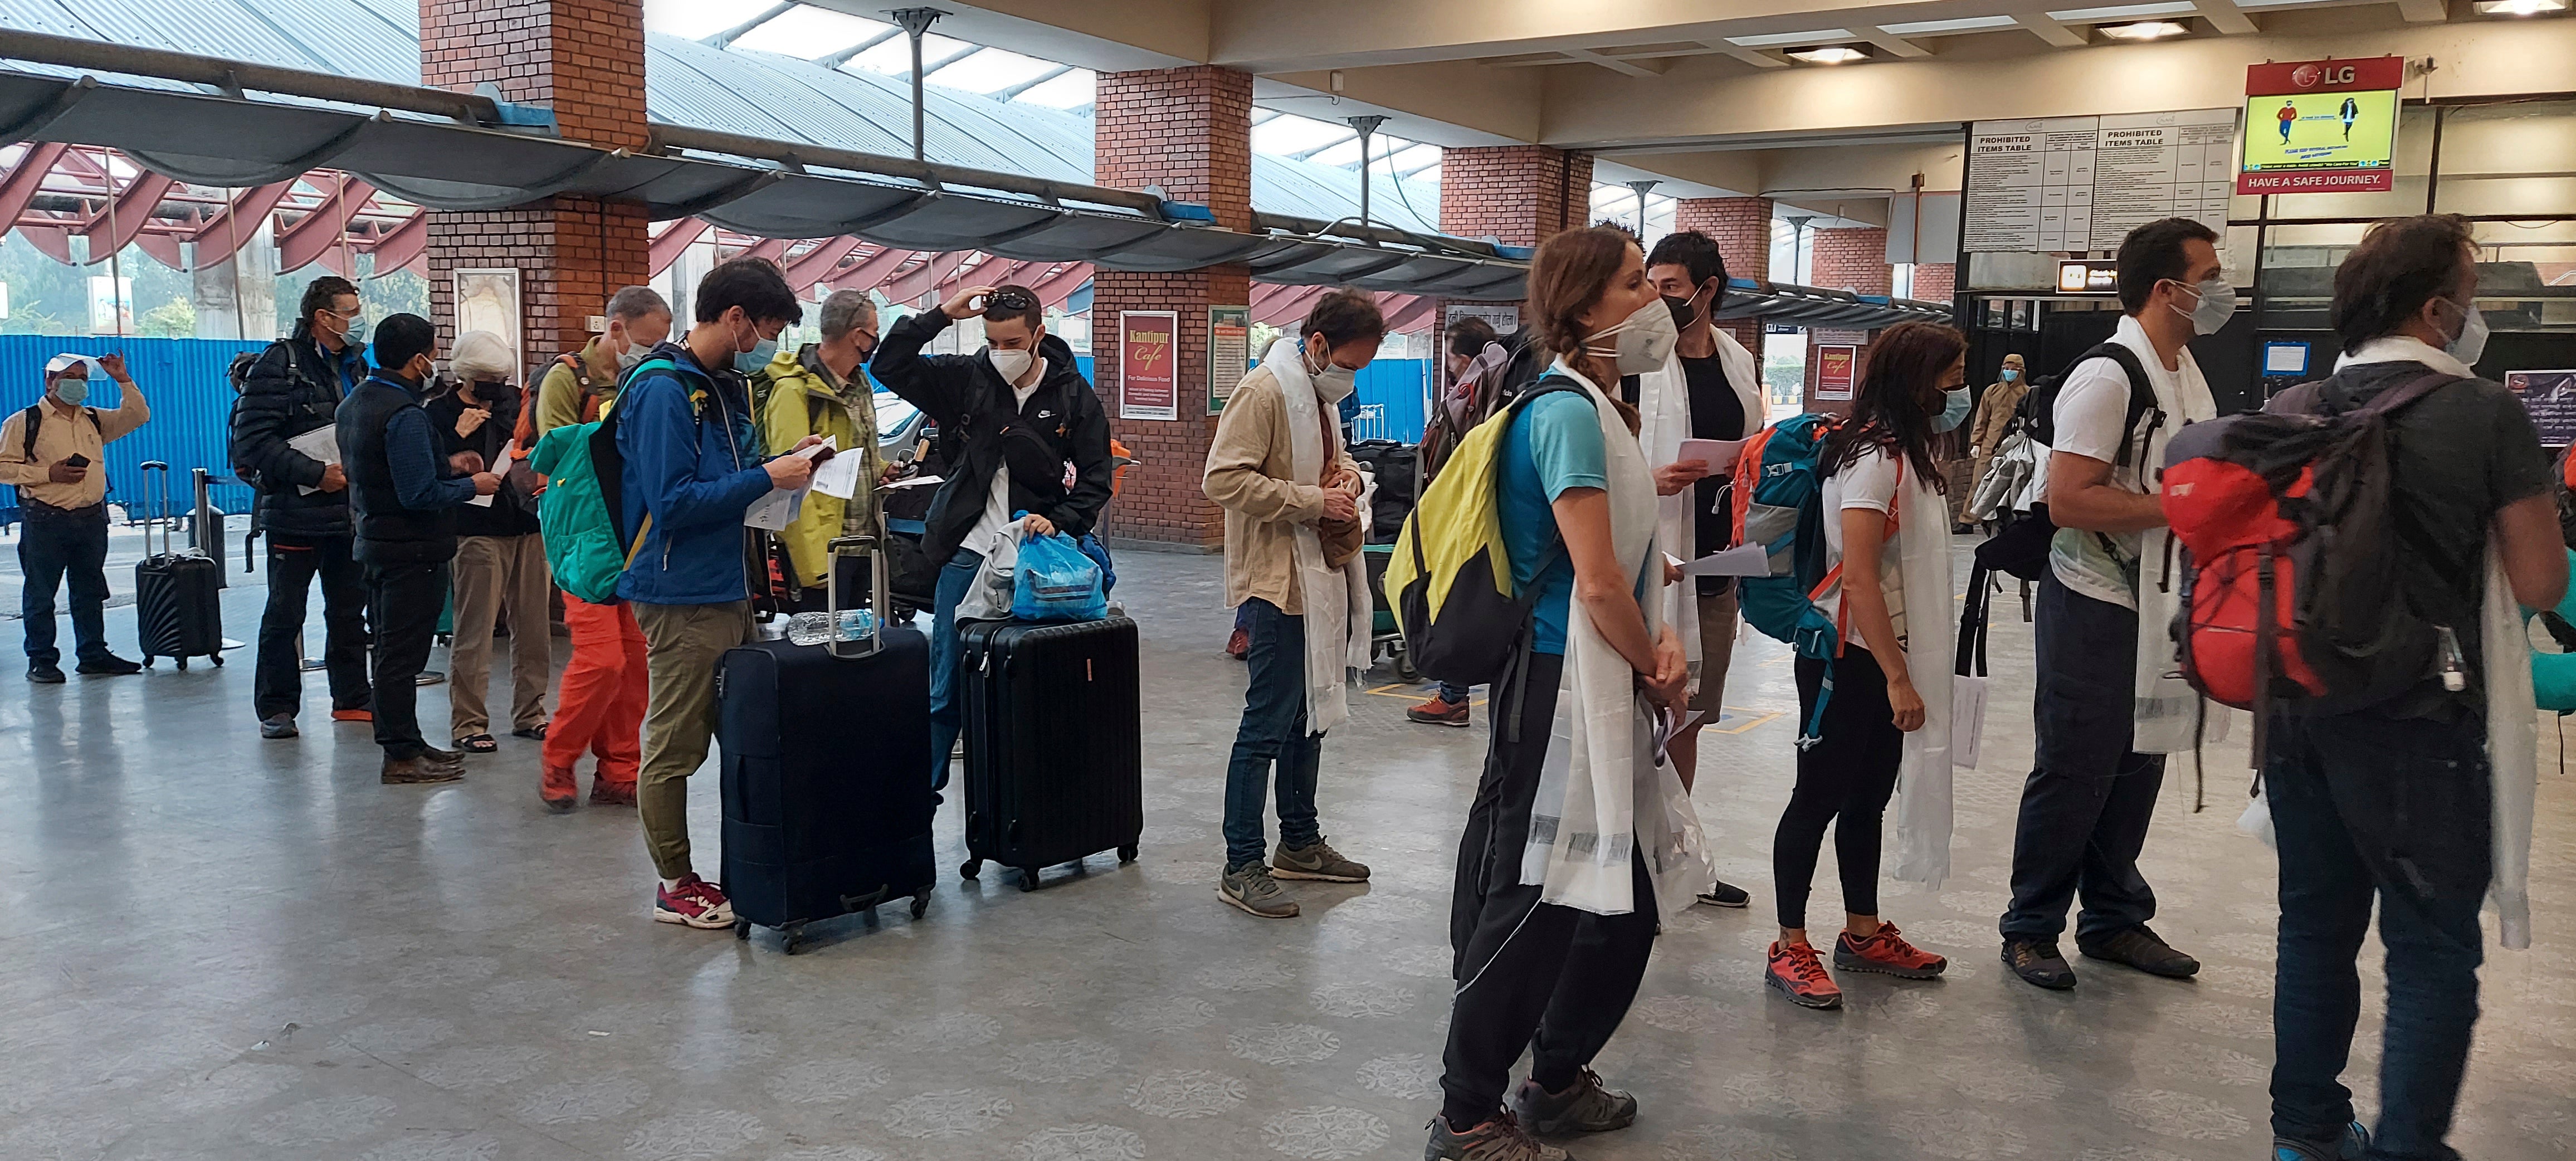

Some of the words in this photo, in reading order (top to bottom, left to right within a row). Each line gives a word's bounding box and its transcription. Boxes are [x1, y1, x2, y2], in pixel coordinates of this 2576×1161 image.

[2325, 66, 2355, 84] LG
[2108, 130, 2163, 138] PROHIBITED
[2248, 178, 2279, 187] HAVE
[2281, 177, 2290, 186] A
[2293, 176, 2323, 186] SAFE
[2324, 174, 2380, 185] JOURNEY.
[1130, 330, 1169, 345] Kantipur
[1134, 344, 1164, 370] Cafe
